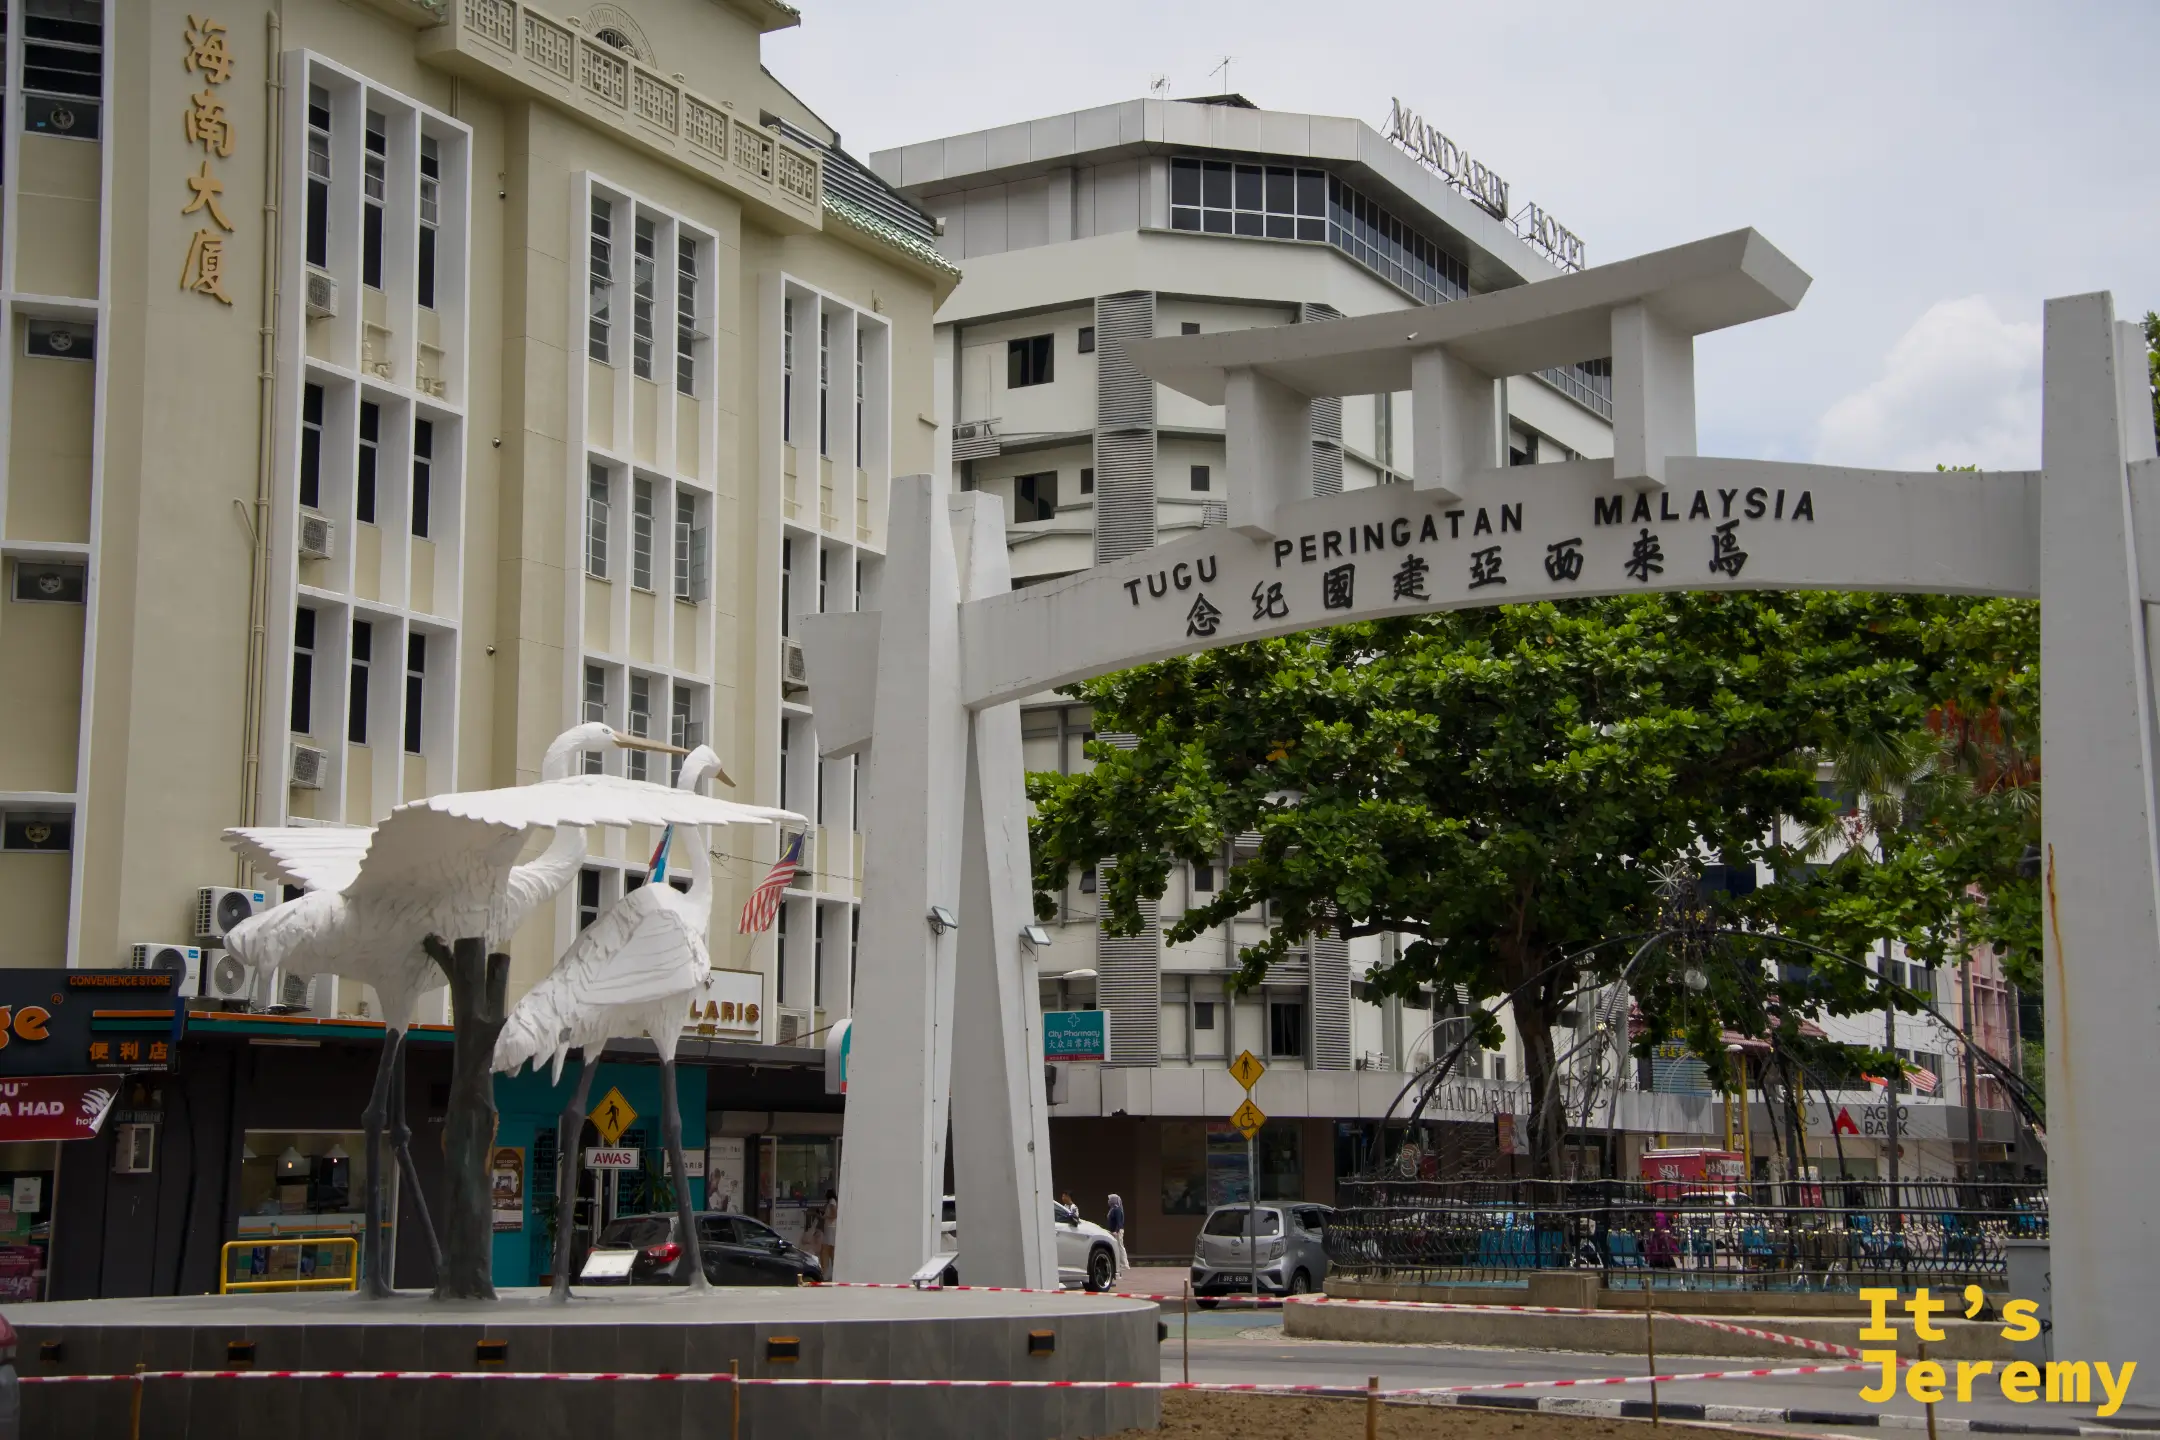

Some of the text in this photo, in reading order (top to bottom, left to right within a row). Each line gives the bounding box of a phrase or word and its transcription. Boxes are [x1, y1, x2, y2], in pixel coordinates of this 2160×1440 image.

[1391, 96, 1586, 271] MANDARIN HOTEL
[1123, 486, 1815, 606] TUGU PERINGATAN MALAYSIA
[69, 976, 171, 986] CONVENIENCE STORE
[1048, 1029, 1100, 1039] City Pharmacy
[89, 1041, 169, 1062] 便利店
[18, 1101, 65, 1117] HAD
[1864, 1106, 1909, 1120] AGO
[1864, 1121, 1909, 1136] BAK
[593, 1152, 632, 1165] AWAS
